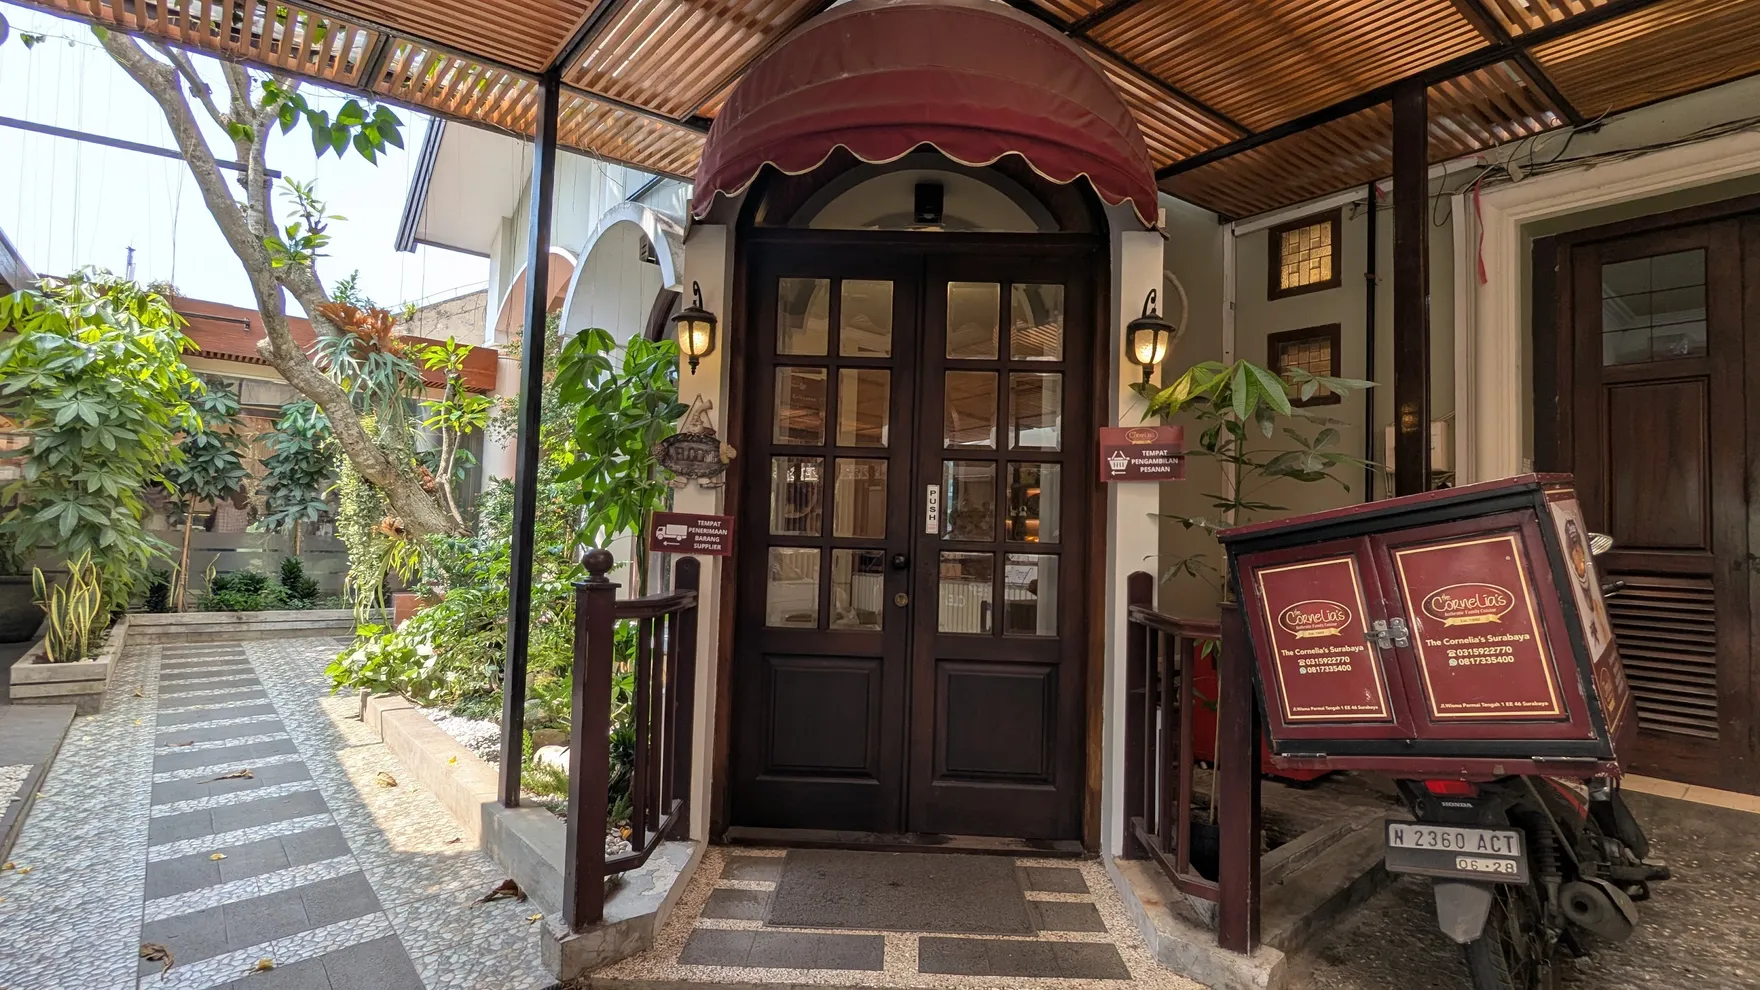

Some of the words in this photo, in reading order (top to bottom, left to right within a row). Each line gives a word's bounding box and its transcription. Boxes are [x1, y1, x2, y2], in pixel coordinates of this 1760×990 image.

[928, 490, 936, 520] PUSH
[688, 527, 728, 535] PENERIMAAN
[1443, 636, 1486, 646] Cornelia's
[1487, 632, 1530, 643] Surabaya
[1295, 647, 1329, 656] Cornelia's
[1330, 644, 1364, 654] Surabaya
[1457, 646, 1512, 656] 0315922770
[1306, 656, 1350, 665] 0315922770
[1458, 656, 1514, 665] 0817335400
[1307, 665, 1351, 674] 0817335400
[1394, 829, 1404, 845] N
[1414, 830, 1465, 849] 2360
[1478, 834, 1514, 853] ACT
